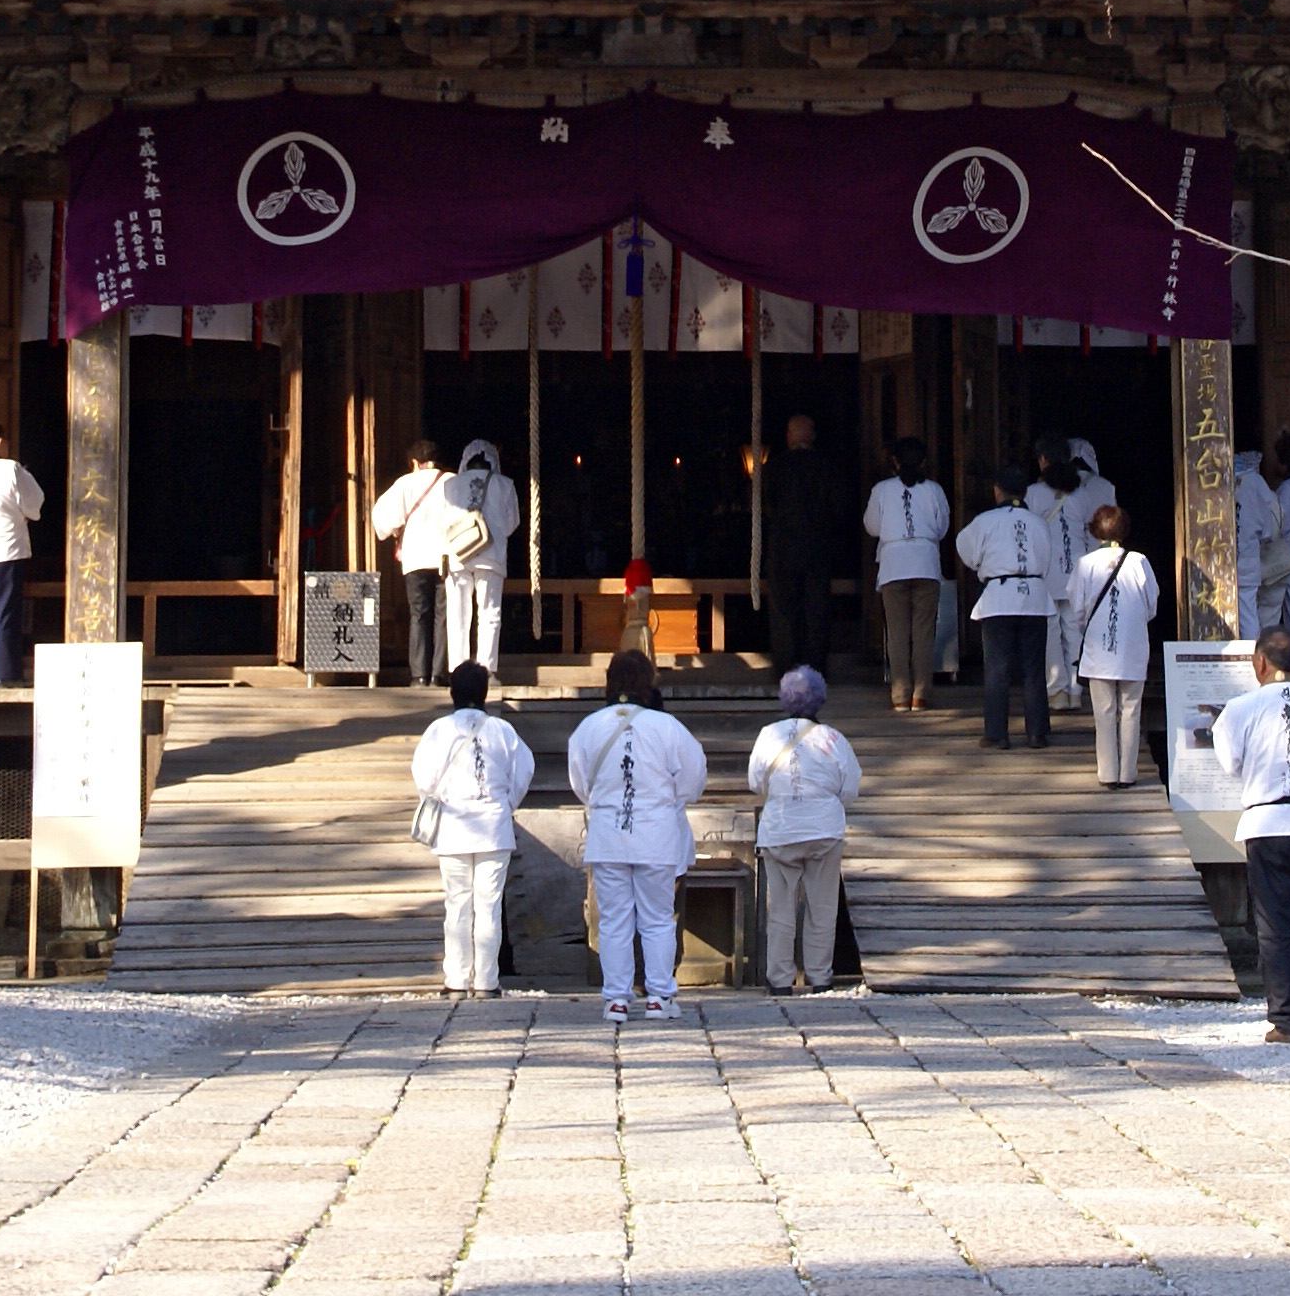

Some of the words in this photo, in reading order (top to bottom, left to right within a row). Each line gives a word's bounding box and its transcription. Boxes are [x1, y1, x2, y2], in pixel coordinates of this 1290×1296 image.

[540, 117, 569, 144] 納
[702, 115, 735, 150] 奉
[137, 125, 162, 201] 平成十九年
[147, 207, 167, 267] 四月吉日
[332, 603, 354, 661] 納札入
